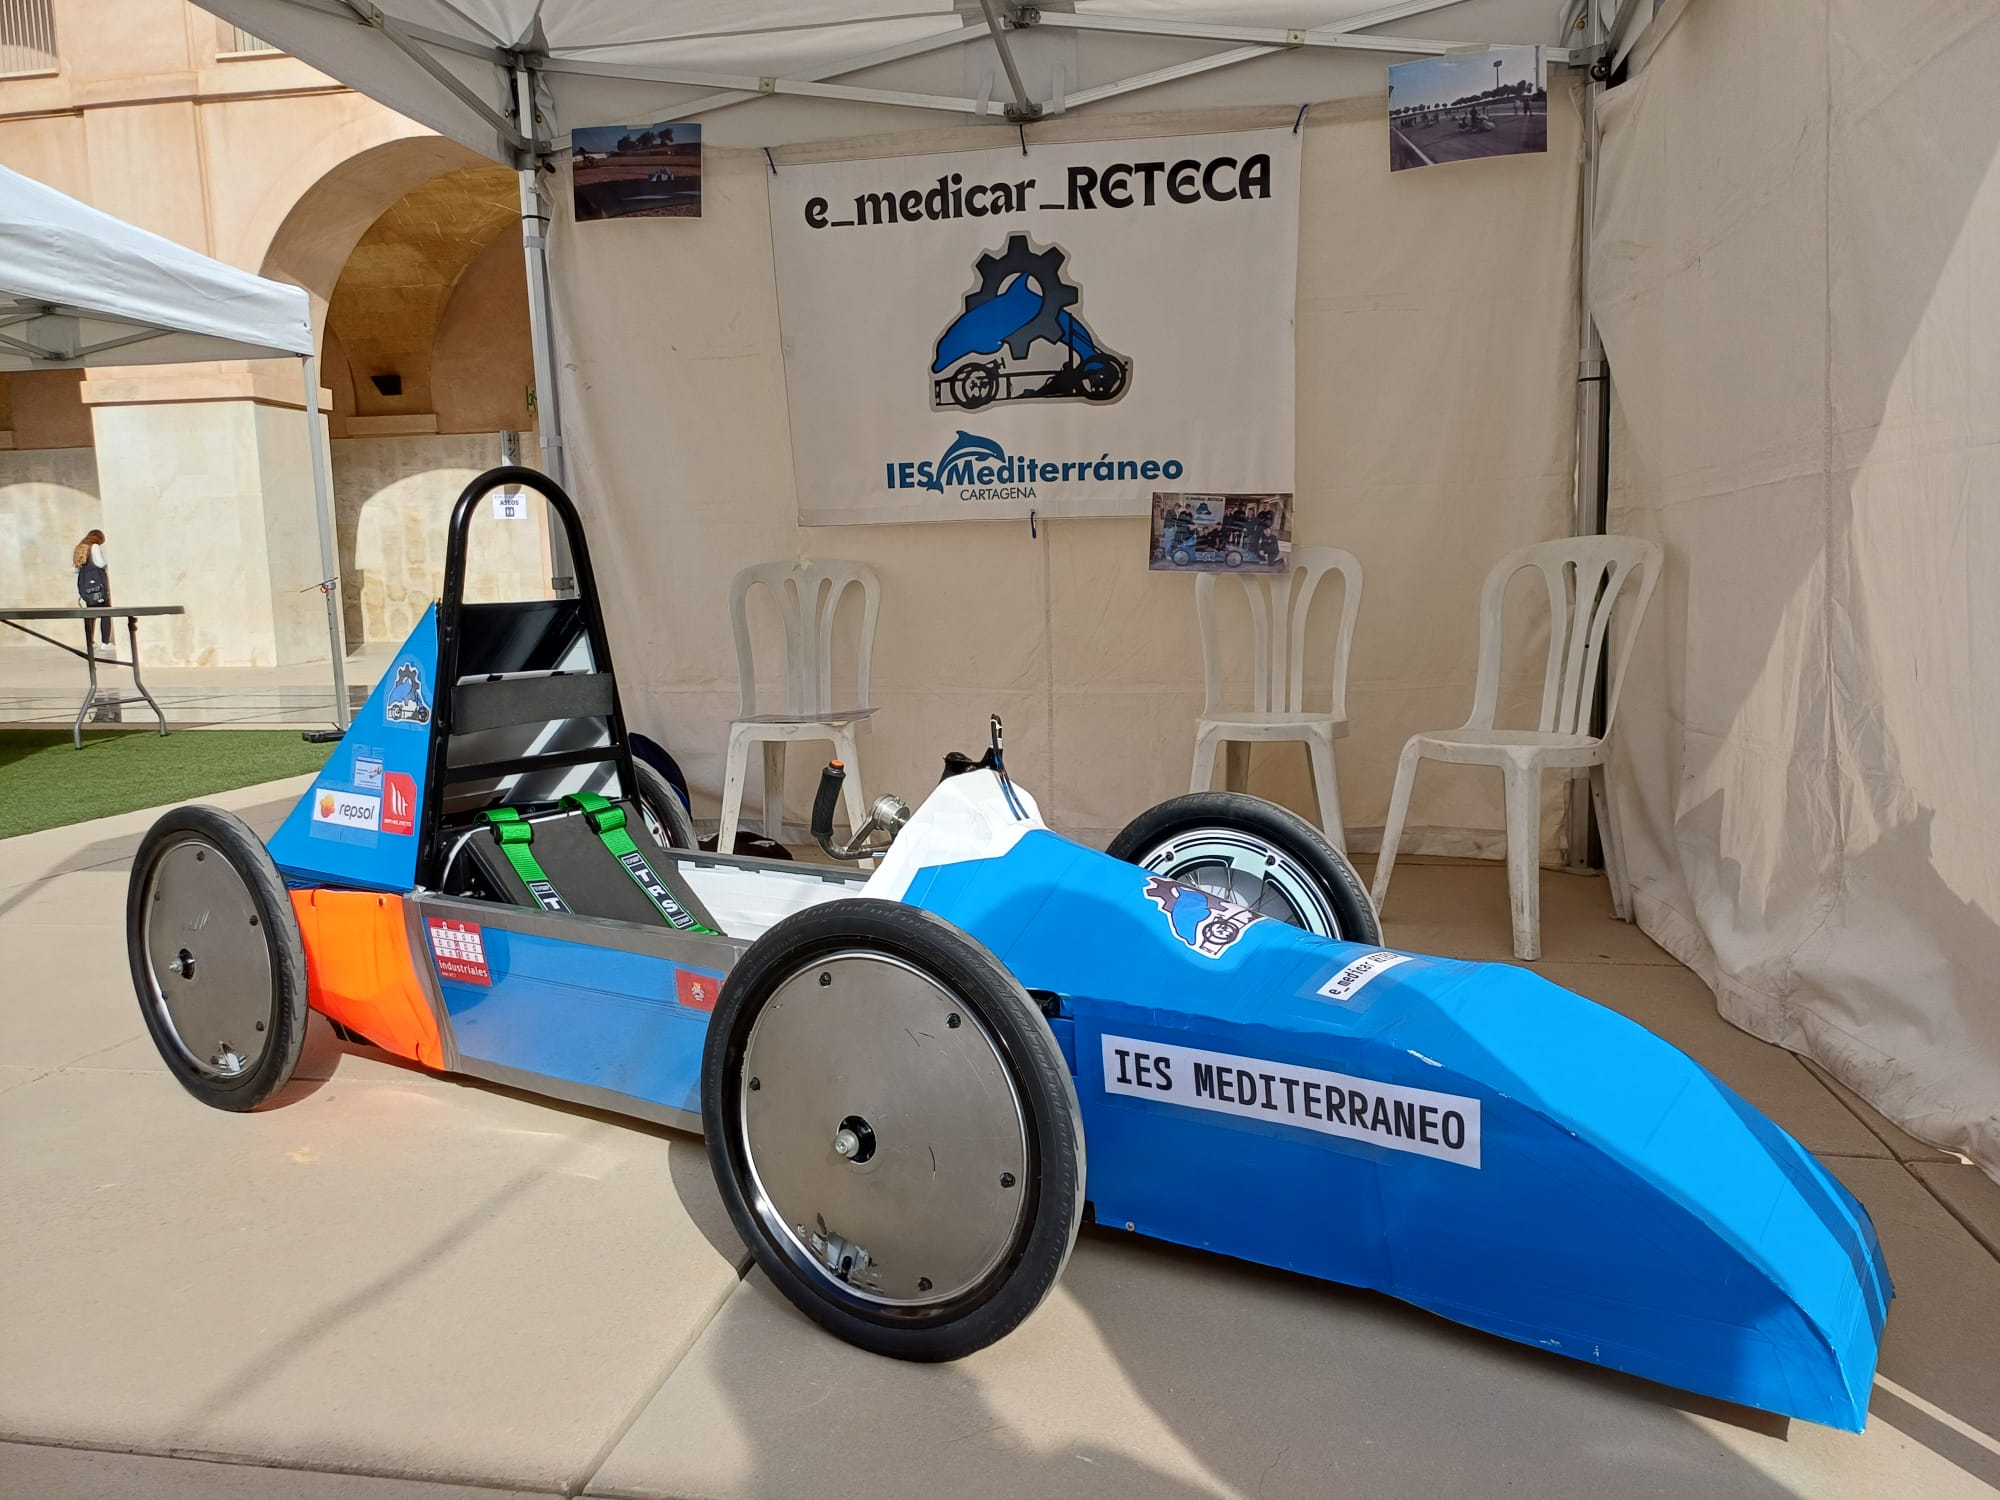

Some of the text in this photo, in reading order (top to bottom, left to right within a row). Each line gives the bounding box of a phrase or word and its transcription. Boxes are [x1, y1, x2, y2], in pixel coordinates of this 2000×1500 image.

[805, 173, 1036, 229] e_medicar
[886, 454, 1184, 490] IES Mediterráneo
[960, 487, 1037, 502] CARTAGENA
[339, 804, 375, 821] repsol
[438, 959, 488, 978] industriales
[1328, 961, 1375, 995] e_medicar
[1114, 1049, 1466, 1151] IES MEDITERRANEO
